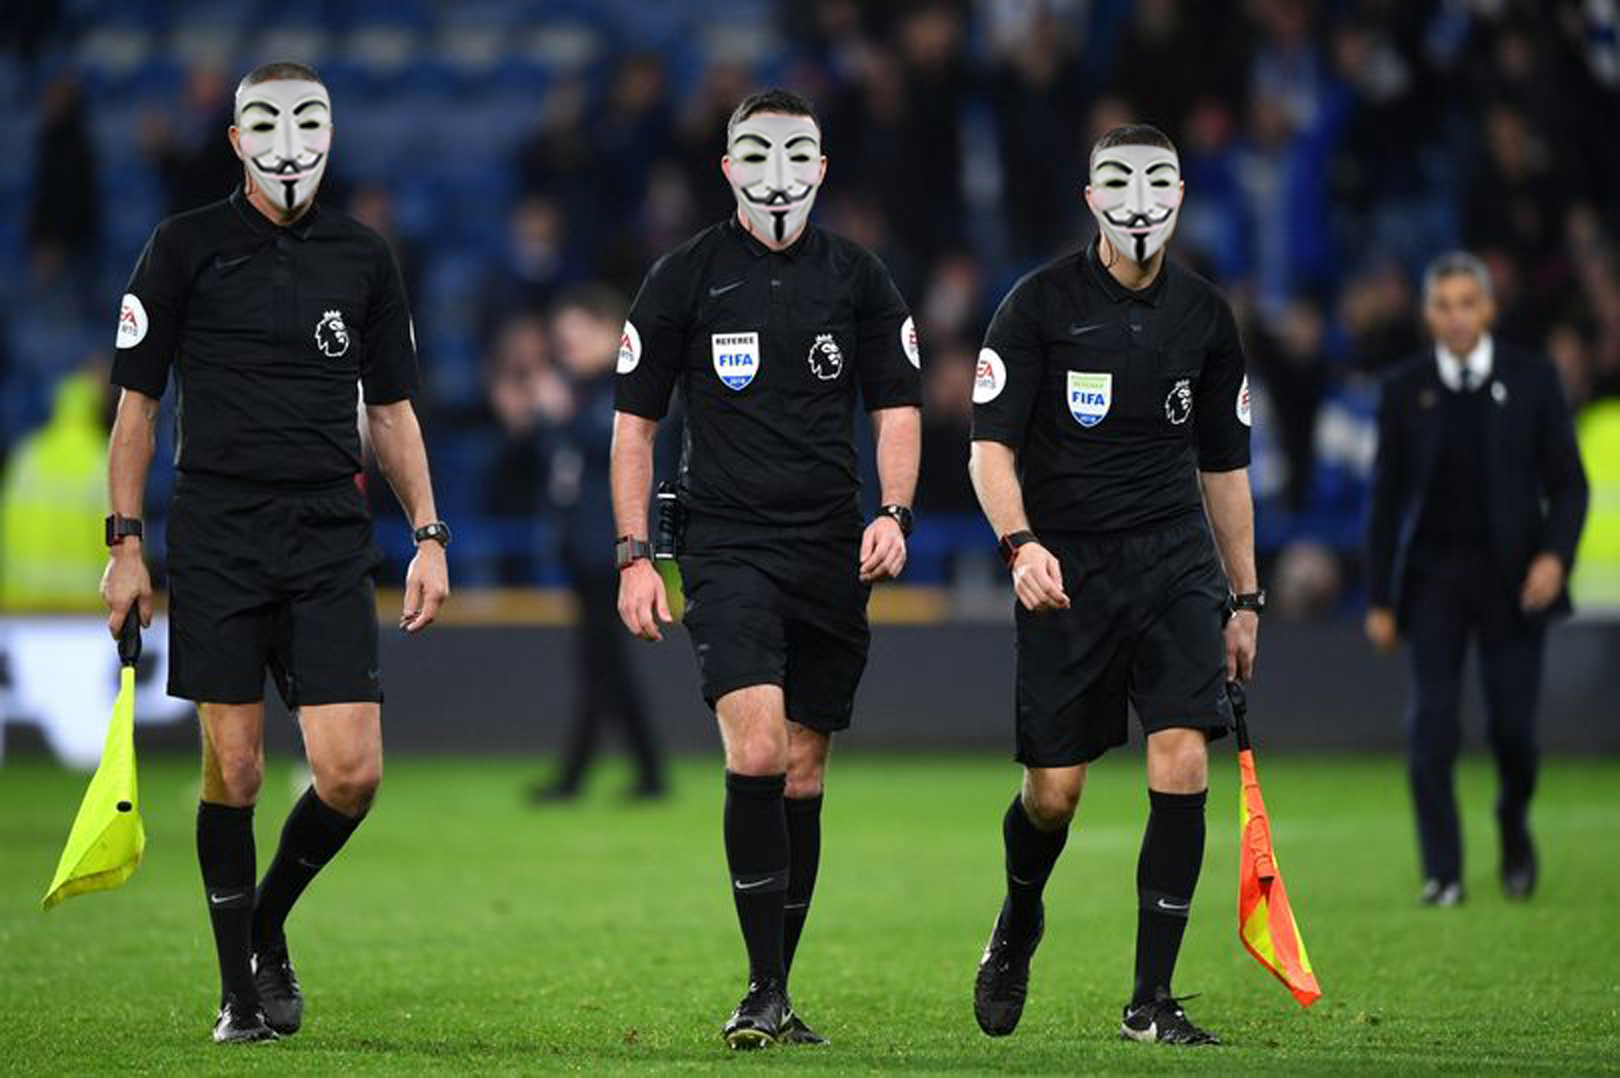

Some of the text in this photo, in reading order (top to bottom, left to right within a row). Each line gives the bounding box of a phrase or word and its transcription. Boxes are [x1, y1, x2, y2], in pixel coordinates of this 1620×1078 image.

[715, 336, 754, 345] REFEREE
[719, 353, 753, 367] FIFA
[1072, 391, 1105, 406] FIFA
